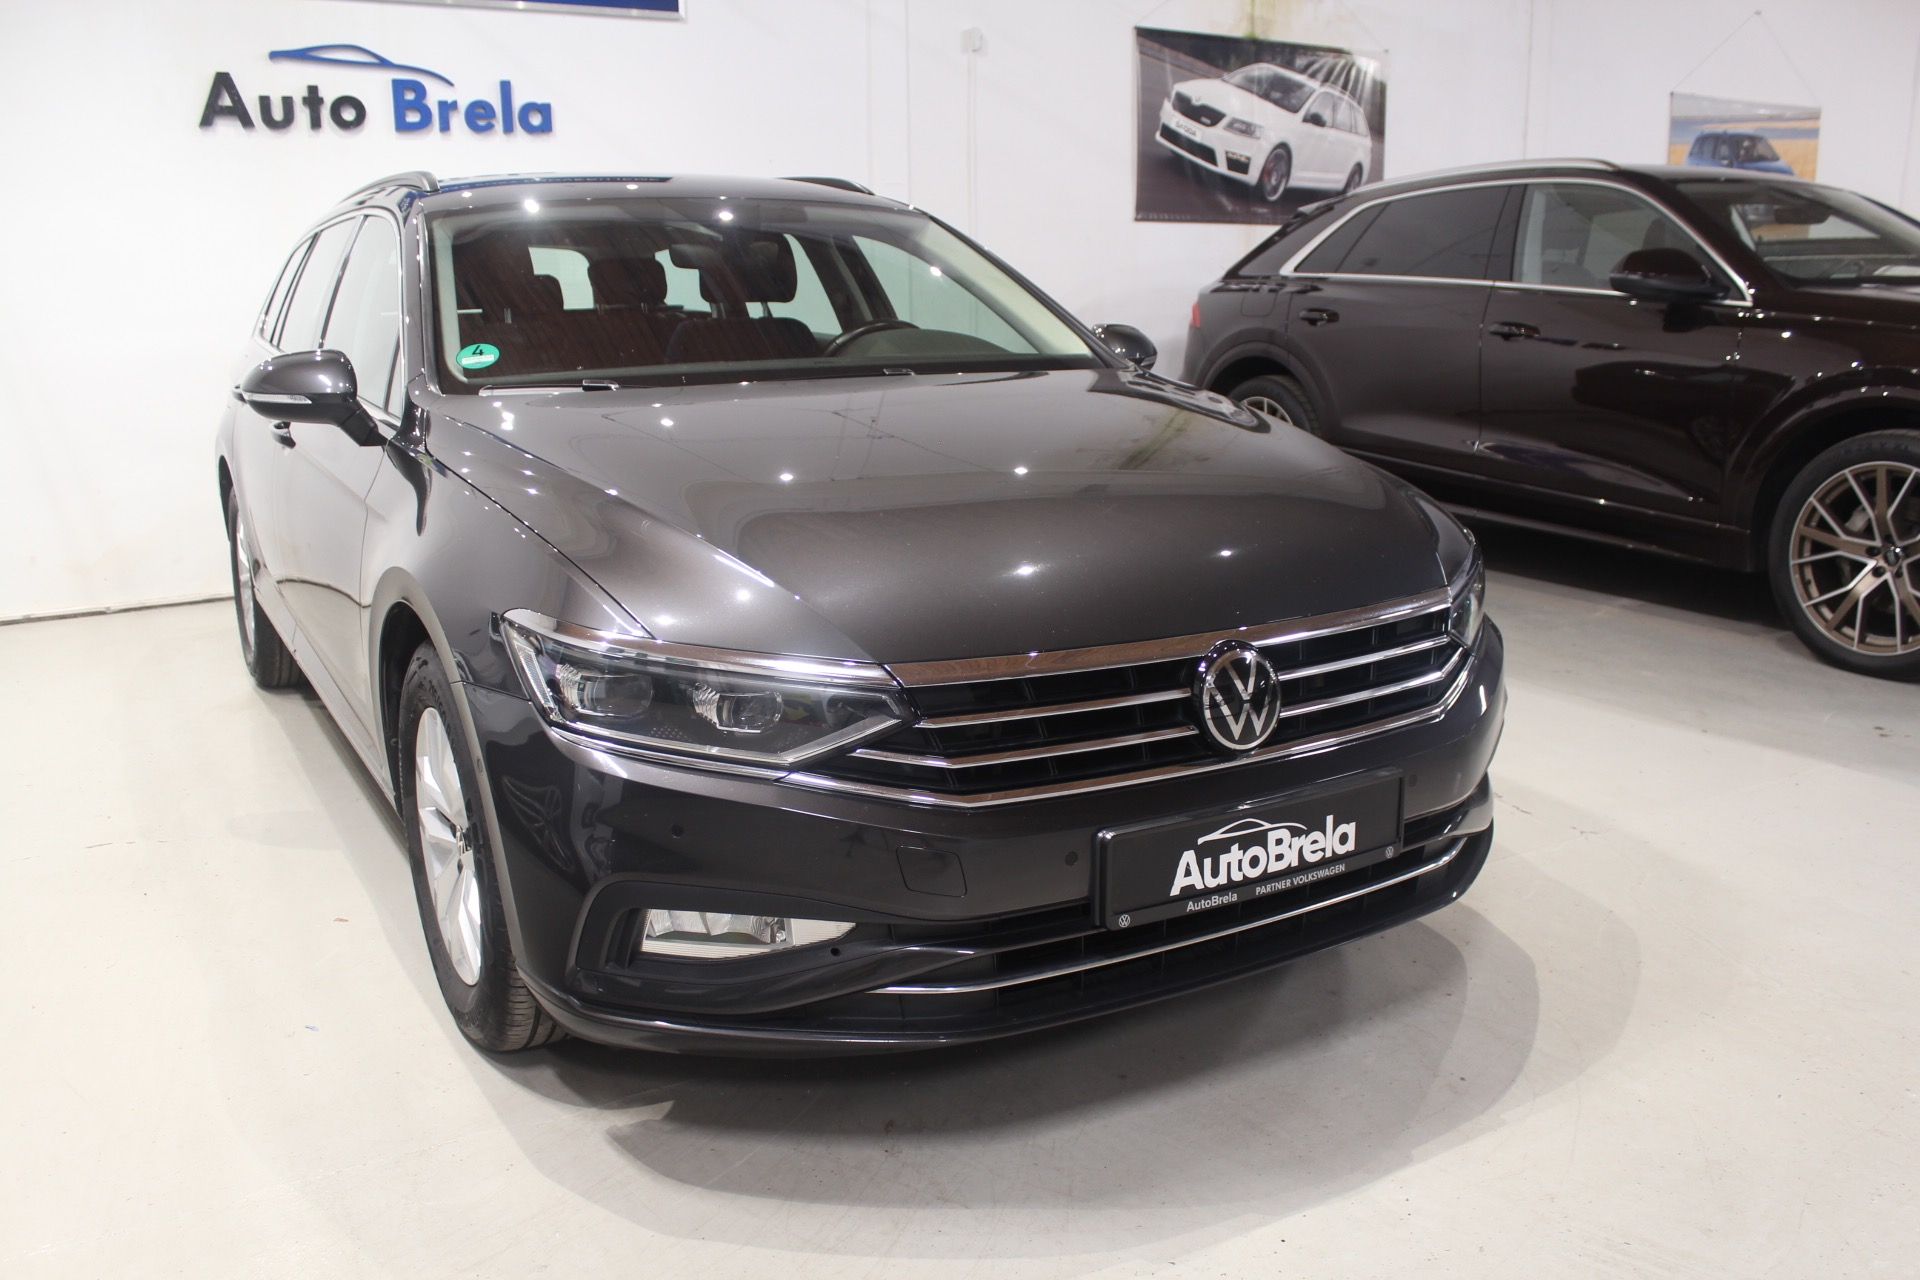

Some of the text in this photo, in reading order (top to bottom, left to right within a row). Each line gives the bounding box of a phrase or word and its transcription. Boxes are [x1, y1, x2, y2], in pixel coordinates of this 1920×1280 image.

[199, 71, 553, 134] Auto Brela
[472, 344, 484, 356] 4
[1169, 814, 1357, 897] AutoBrela
[1255, 863, 1346, 896] PARTNER VOLKSWAGEN
[1186, 892, 1238, 912] AutoBrela
